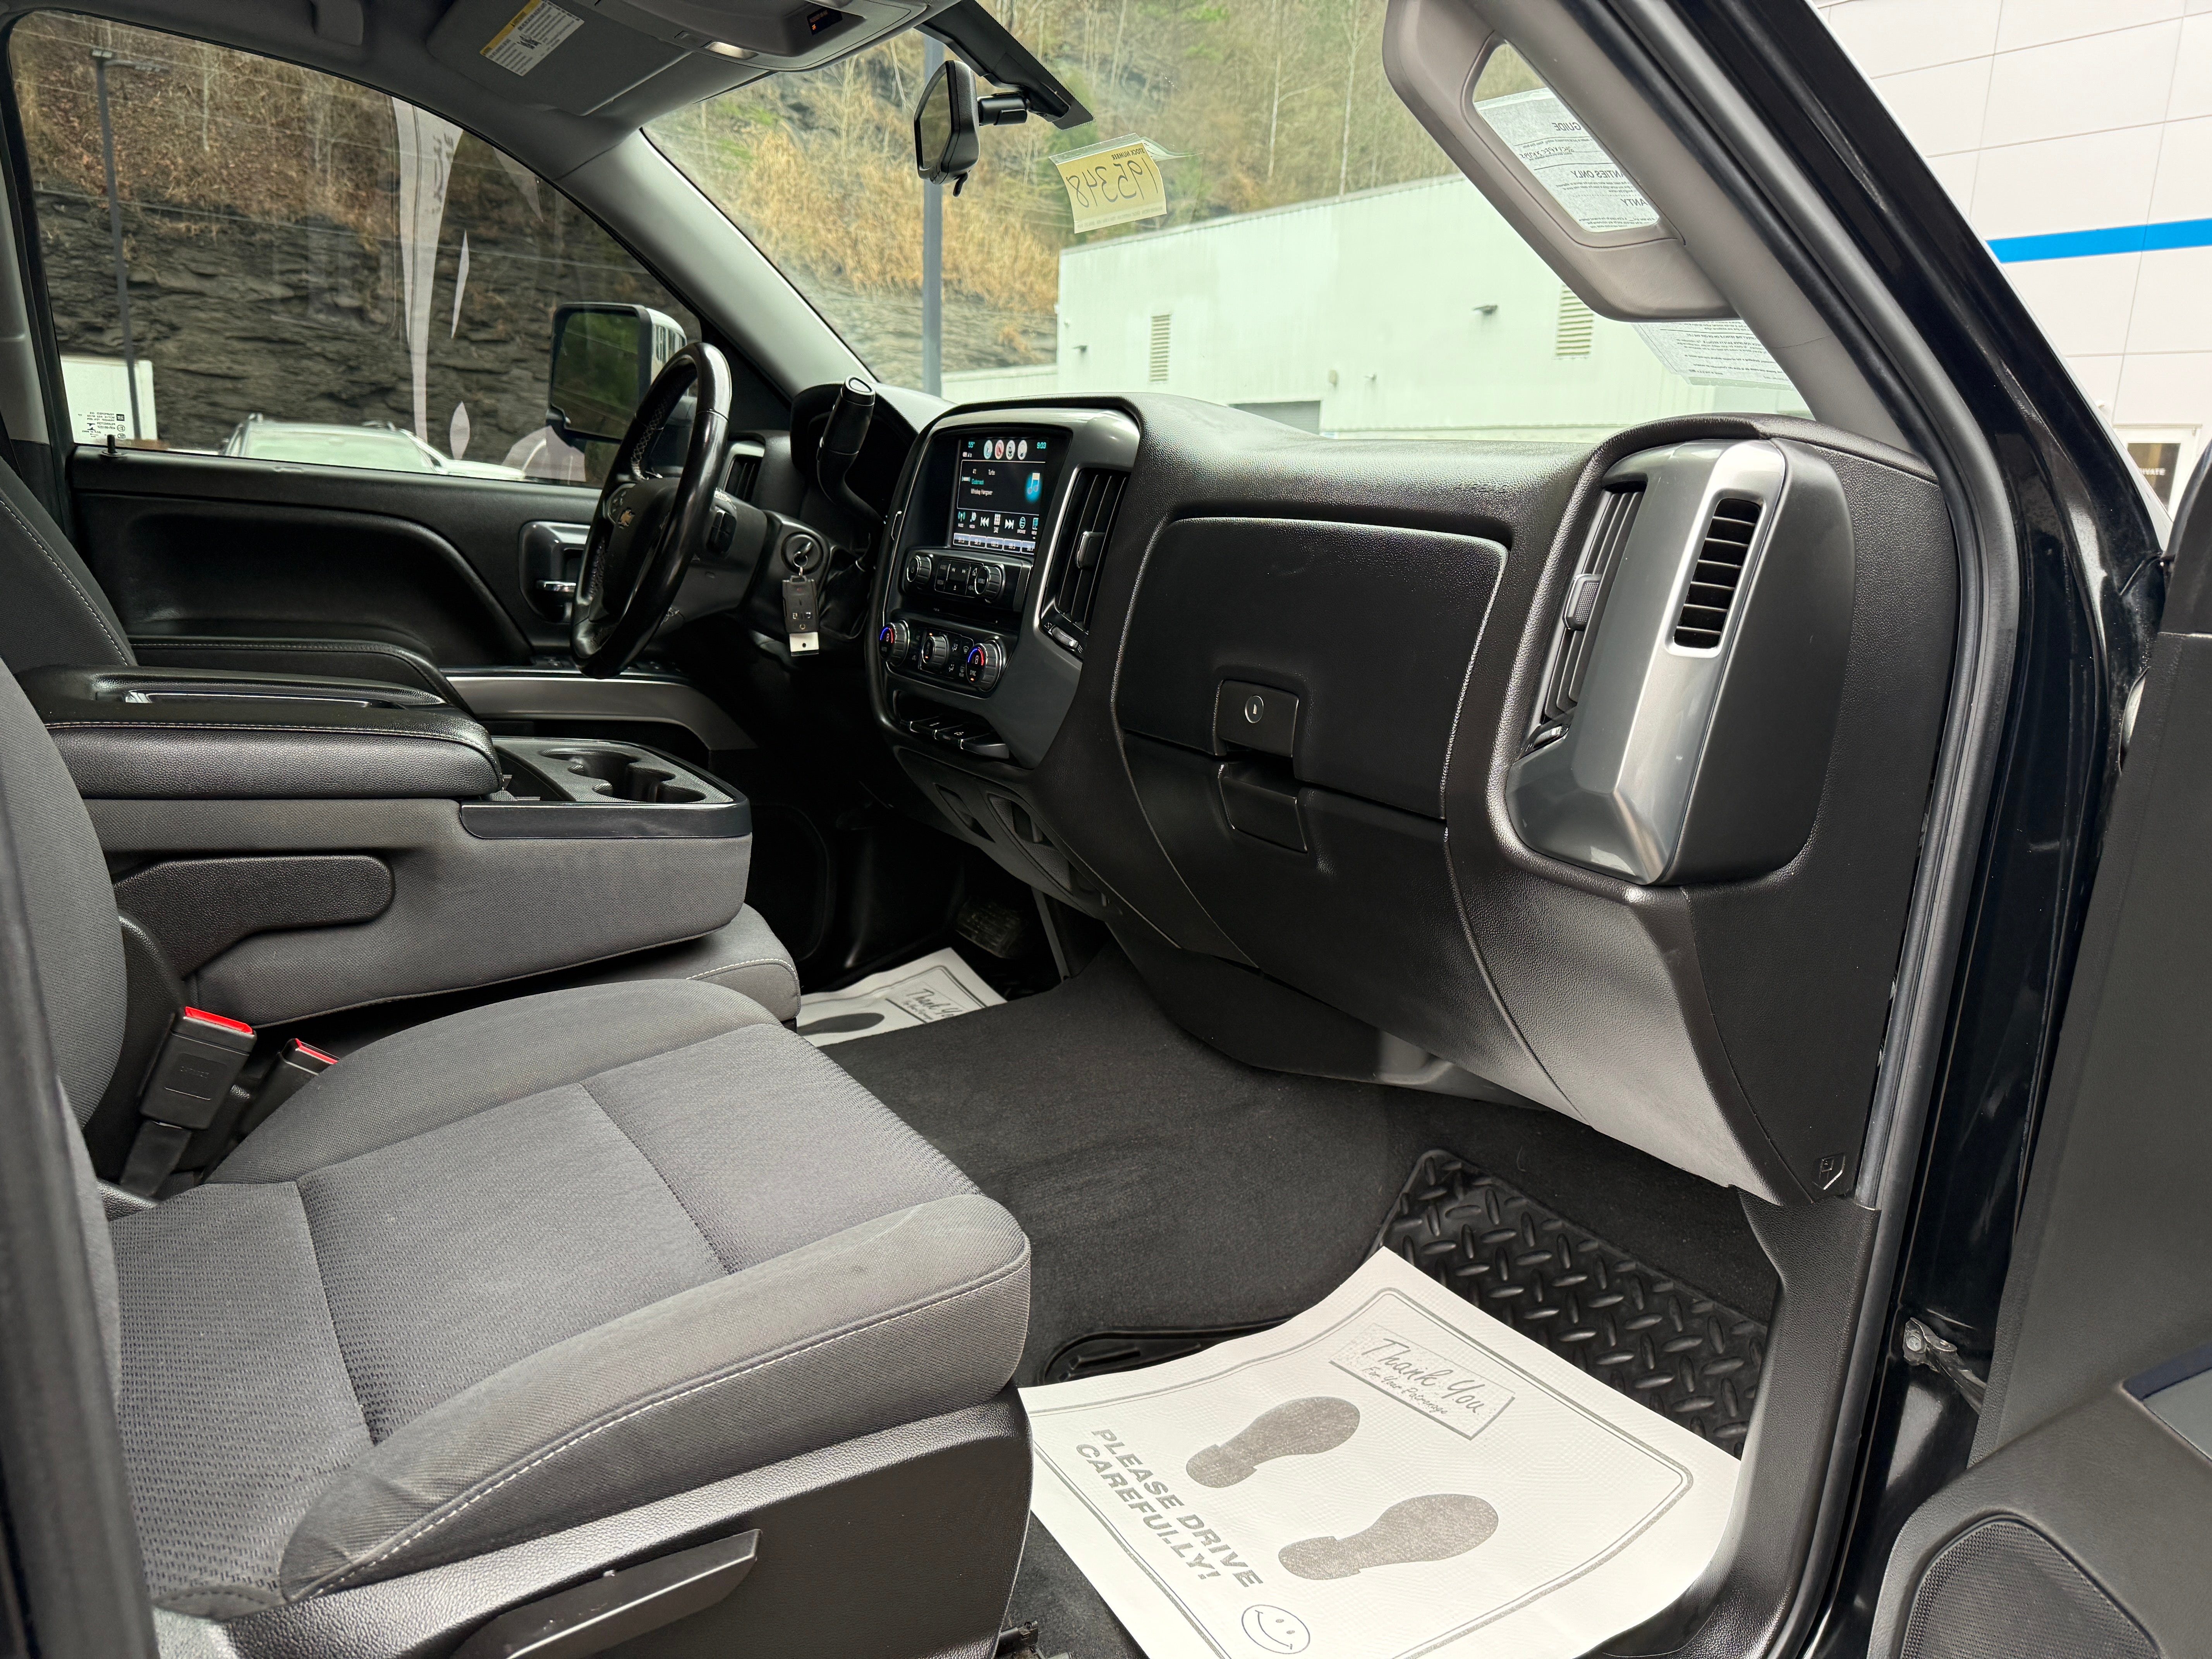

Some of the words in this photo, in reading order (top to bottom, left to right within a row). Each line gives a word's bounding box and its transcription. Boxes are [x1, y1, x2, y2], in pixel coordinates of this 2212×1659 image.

[935, 1008, 963, 1017] Yo
[1361, 1338, 1454, 1386] Thank
[1441, 1379, 1486, 1413] You
[1362, 1366, 1381, 1377] For
[1381, 1376, 1403, 1389] Your
[1401, 1387, 1448, 1414] Patronage
[1076, 1444, 1221, 1580] CAREFULLY!
[1091, 1429, 1185, 1510] PLEASE
[1177, 1514, 1264, 1588] DRIVE
